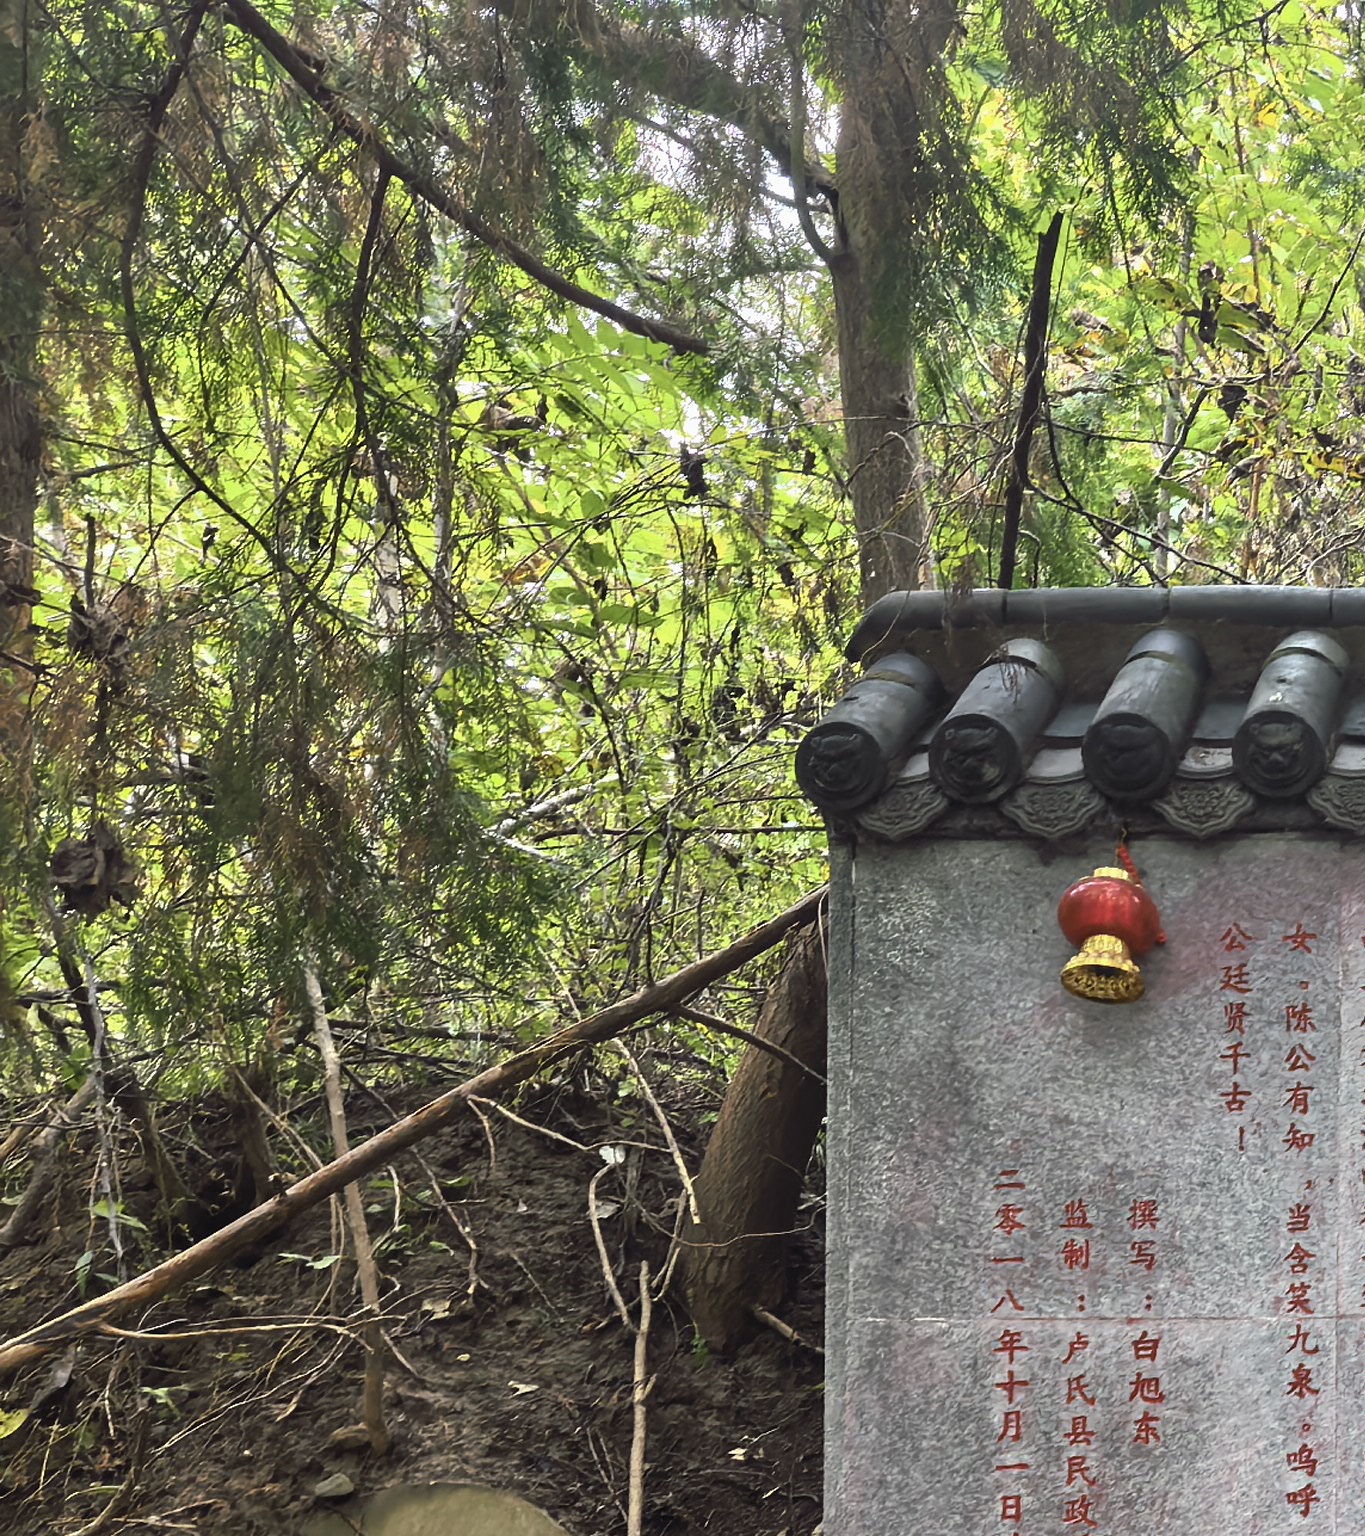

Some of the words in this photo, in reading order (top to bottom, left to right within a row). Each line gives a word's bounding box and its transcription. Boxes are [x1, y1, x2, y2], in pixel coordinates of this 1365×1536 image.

[1218, 921, 1255, 1154] 公廷贤千古！
[1126, 1198, 1165, 1447] 撰写：白旭东
